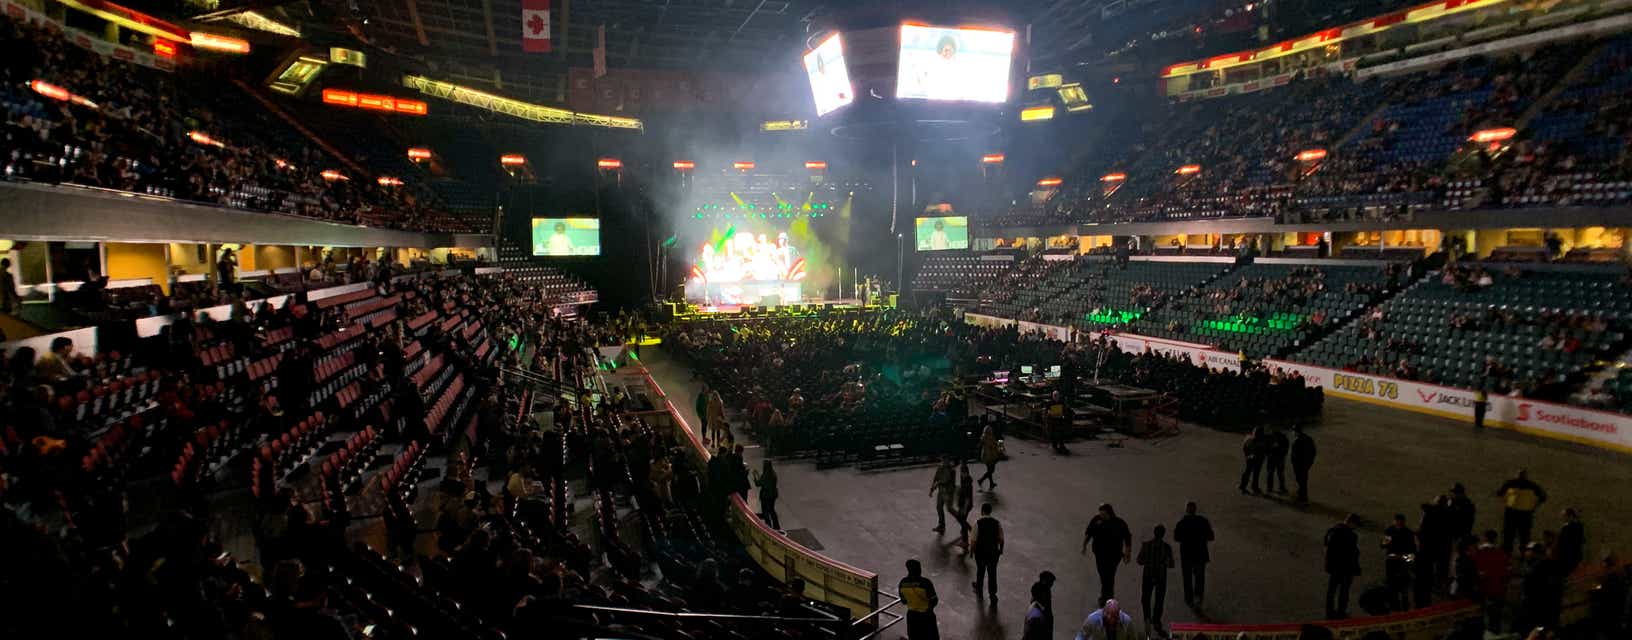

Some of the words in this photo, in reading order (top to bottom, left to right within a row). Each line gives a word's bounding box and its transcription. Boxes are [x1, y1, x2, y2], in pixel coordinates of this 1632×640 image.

[1333, 373, 1375, 395] PIZZA
[1378, 381, 1399, 400] 73
[1535, 409, 1618, 434] Scotiabank
